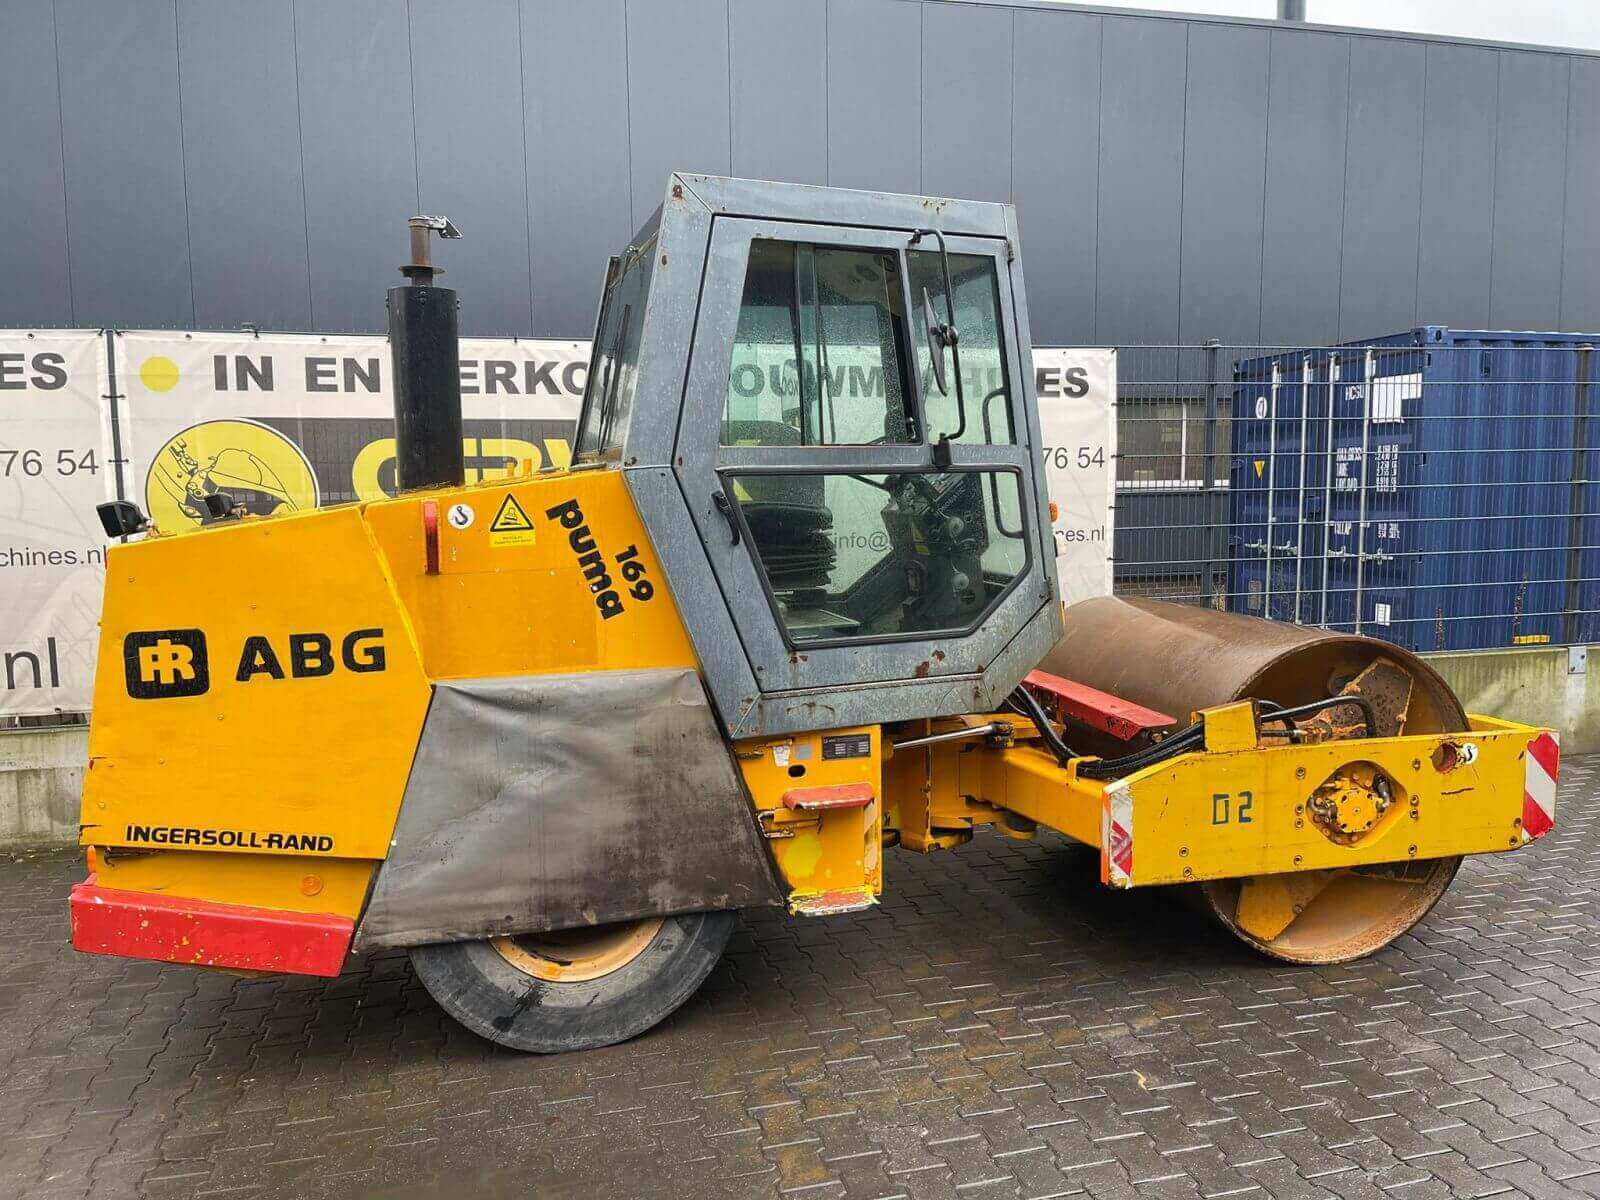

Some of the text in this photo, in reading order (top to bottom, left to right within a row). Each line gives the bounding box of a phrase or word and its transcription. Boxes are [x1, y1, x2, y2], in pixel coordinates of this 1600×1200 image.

[0, 353, 67, 390] ES
[214, 355, 274, 391] IN
[305, 357, 381, 393] EN
[460, 360, 588, 395] ERKO
[57, 449, 99, 476] 54
[1077, 447, 1105, 469] 54
[0, 545, 107, 567] chines.nl
[545, 499, 625, 620] puma
[833, 531, 889, 552] info@
[615, 544, 654, 602] 169
[4, 636, 60, 690] nl
[235, 628, 387, 682] ABG
[125, 825, 335, 852] INGERSOLL-RAND
